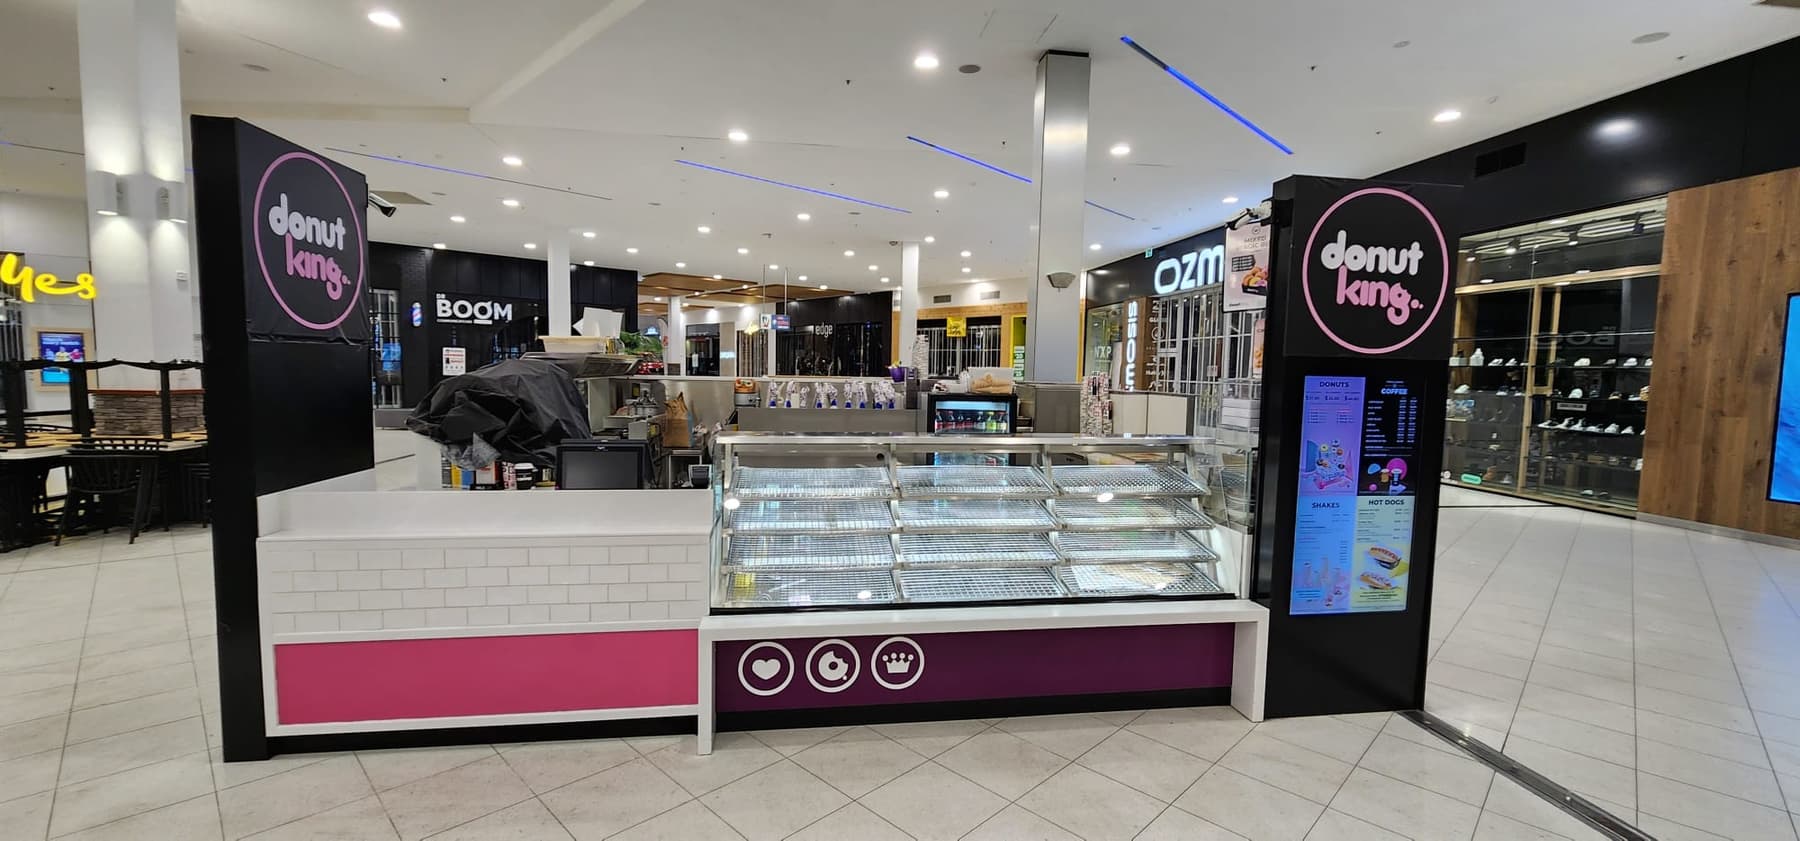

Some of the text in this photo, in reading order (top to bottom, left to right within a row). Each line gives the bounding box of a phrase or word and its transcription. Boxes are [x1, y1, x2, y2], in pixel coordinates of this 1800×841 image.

[268, 193, 346, 250] donut
[285, 233, 342, 300] king
[1321, 230, 1424, 275] donut
[0, 253, 96, 302] yes
[1337, 265, 1412, 326] king
[436, 299, 512, 321] BOOM
[815, 322, 833, 338] edge
[1381, 387, 1408, 395] COFFEE
